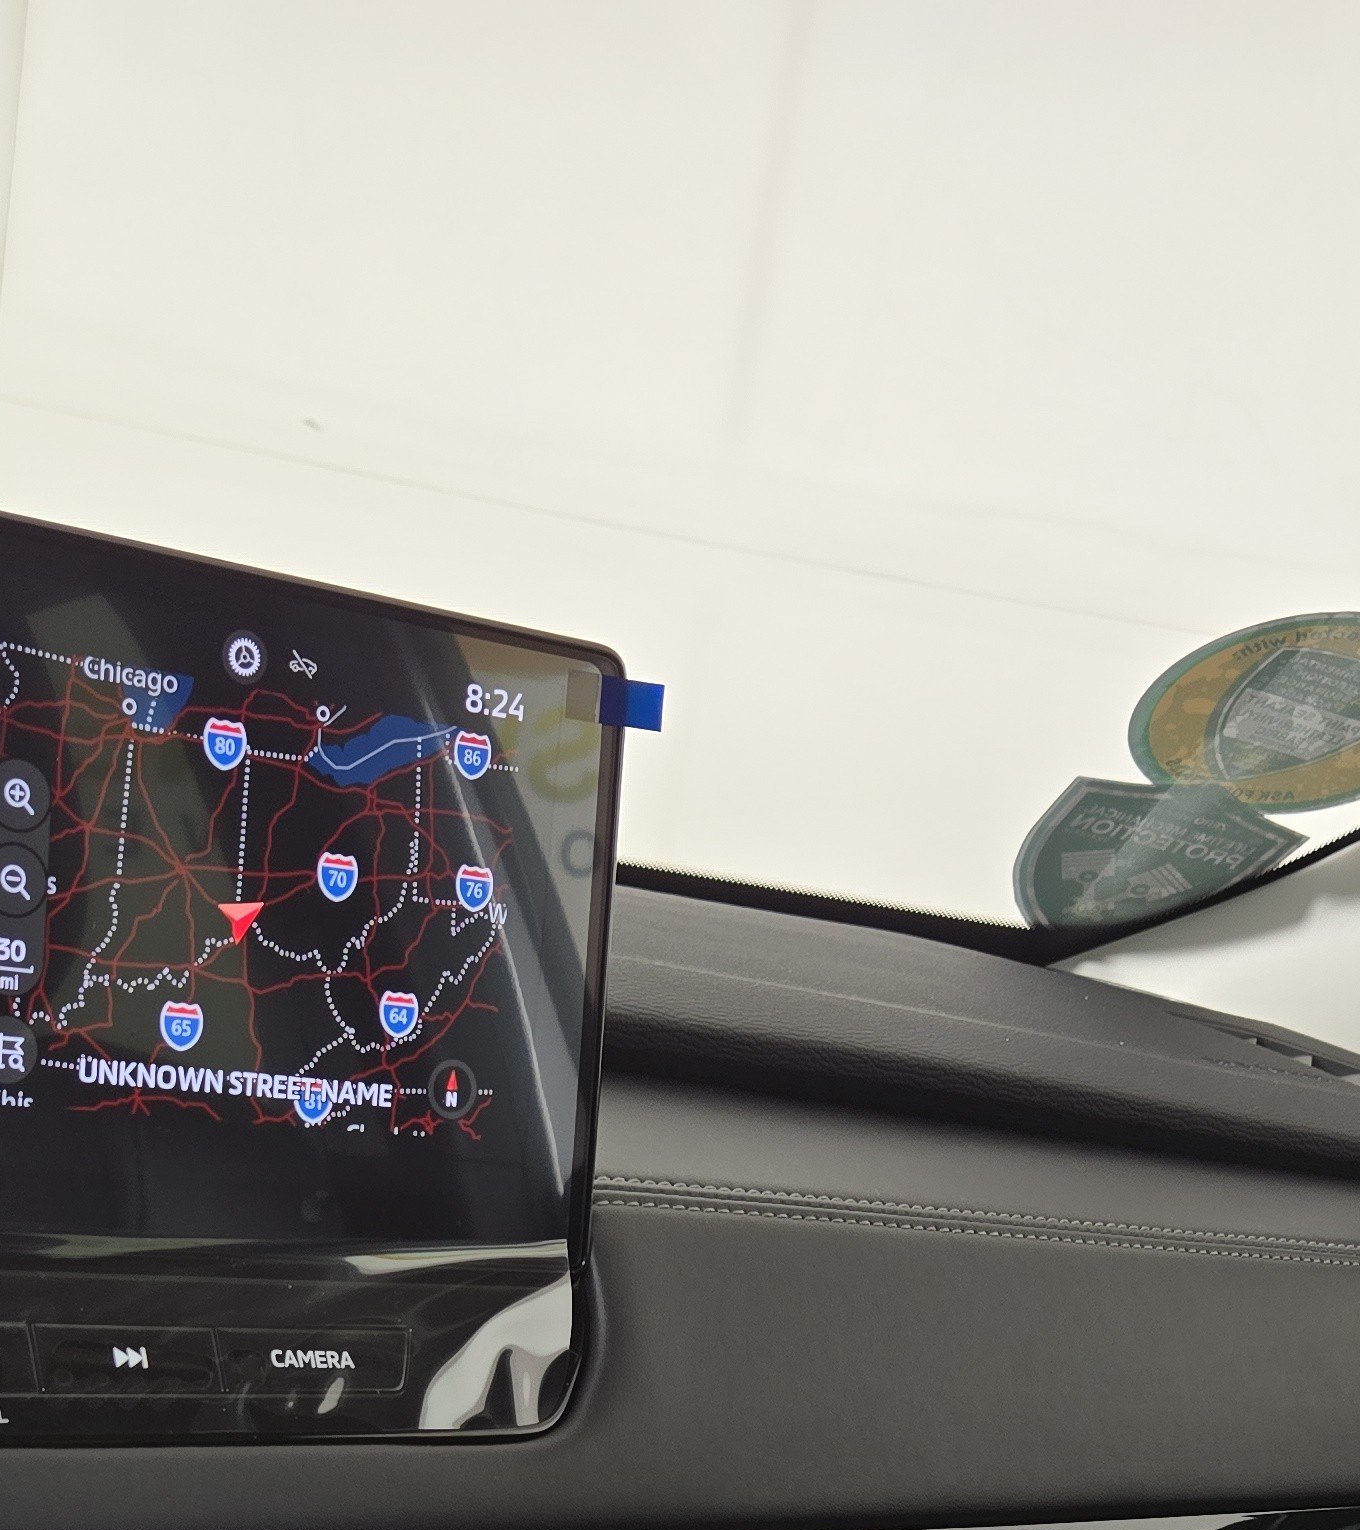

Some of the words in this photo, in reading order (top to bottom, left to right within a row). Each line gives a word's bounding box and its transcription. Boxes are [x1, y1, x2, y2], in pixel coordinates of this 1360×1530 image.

[83, 655, 179, 697] Chicago
[465, 683, 524, 722] 8:24
[214, 736, 235, 756] 80
[464, 749, 482, 766] 86
[328, 869, 347, 889] 70
[465, 881, 483, 899] 76
[0, 973, 19, 991] mi
[389, 1008, 408, 1025] 64
[170, 1019, 192, 1038] 65
[78, 1059, 223, 1094] UNKNOWN
[228, 1069, 317, 1103] STREET
[320, 1079, 394, 1108] NAME
[445, 1091, 458, 1109] N
[270, 1348, 356, 1371] CAMERA
